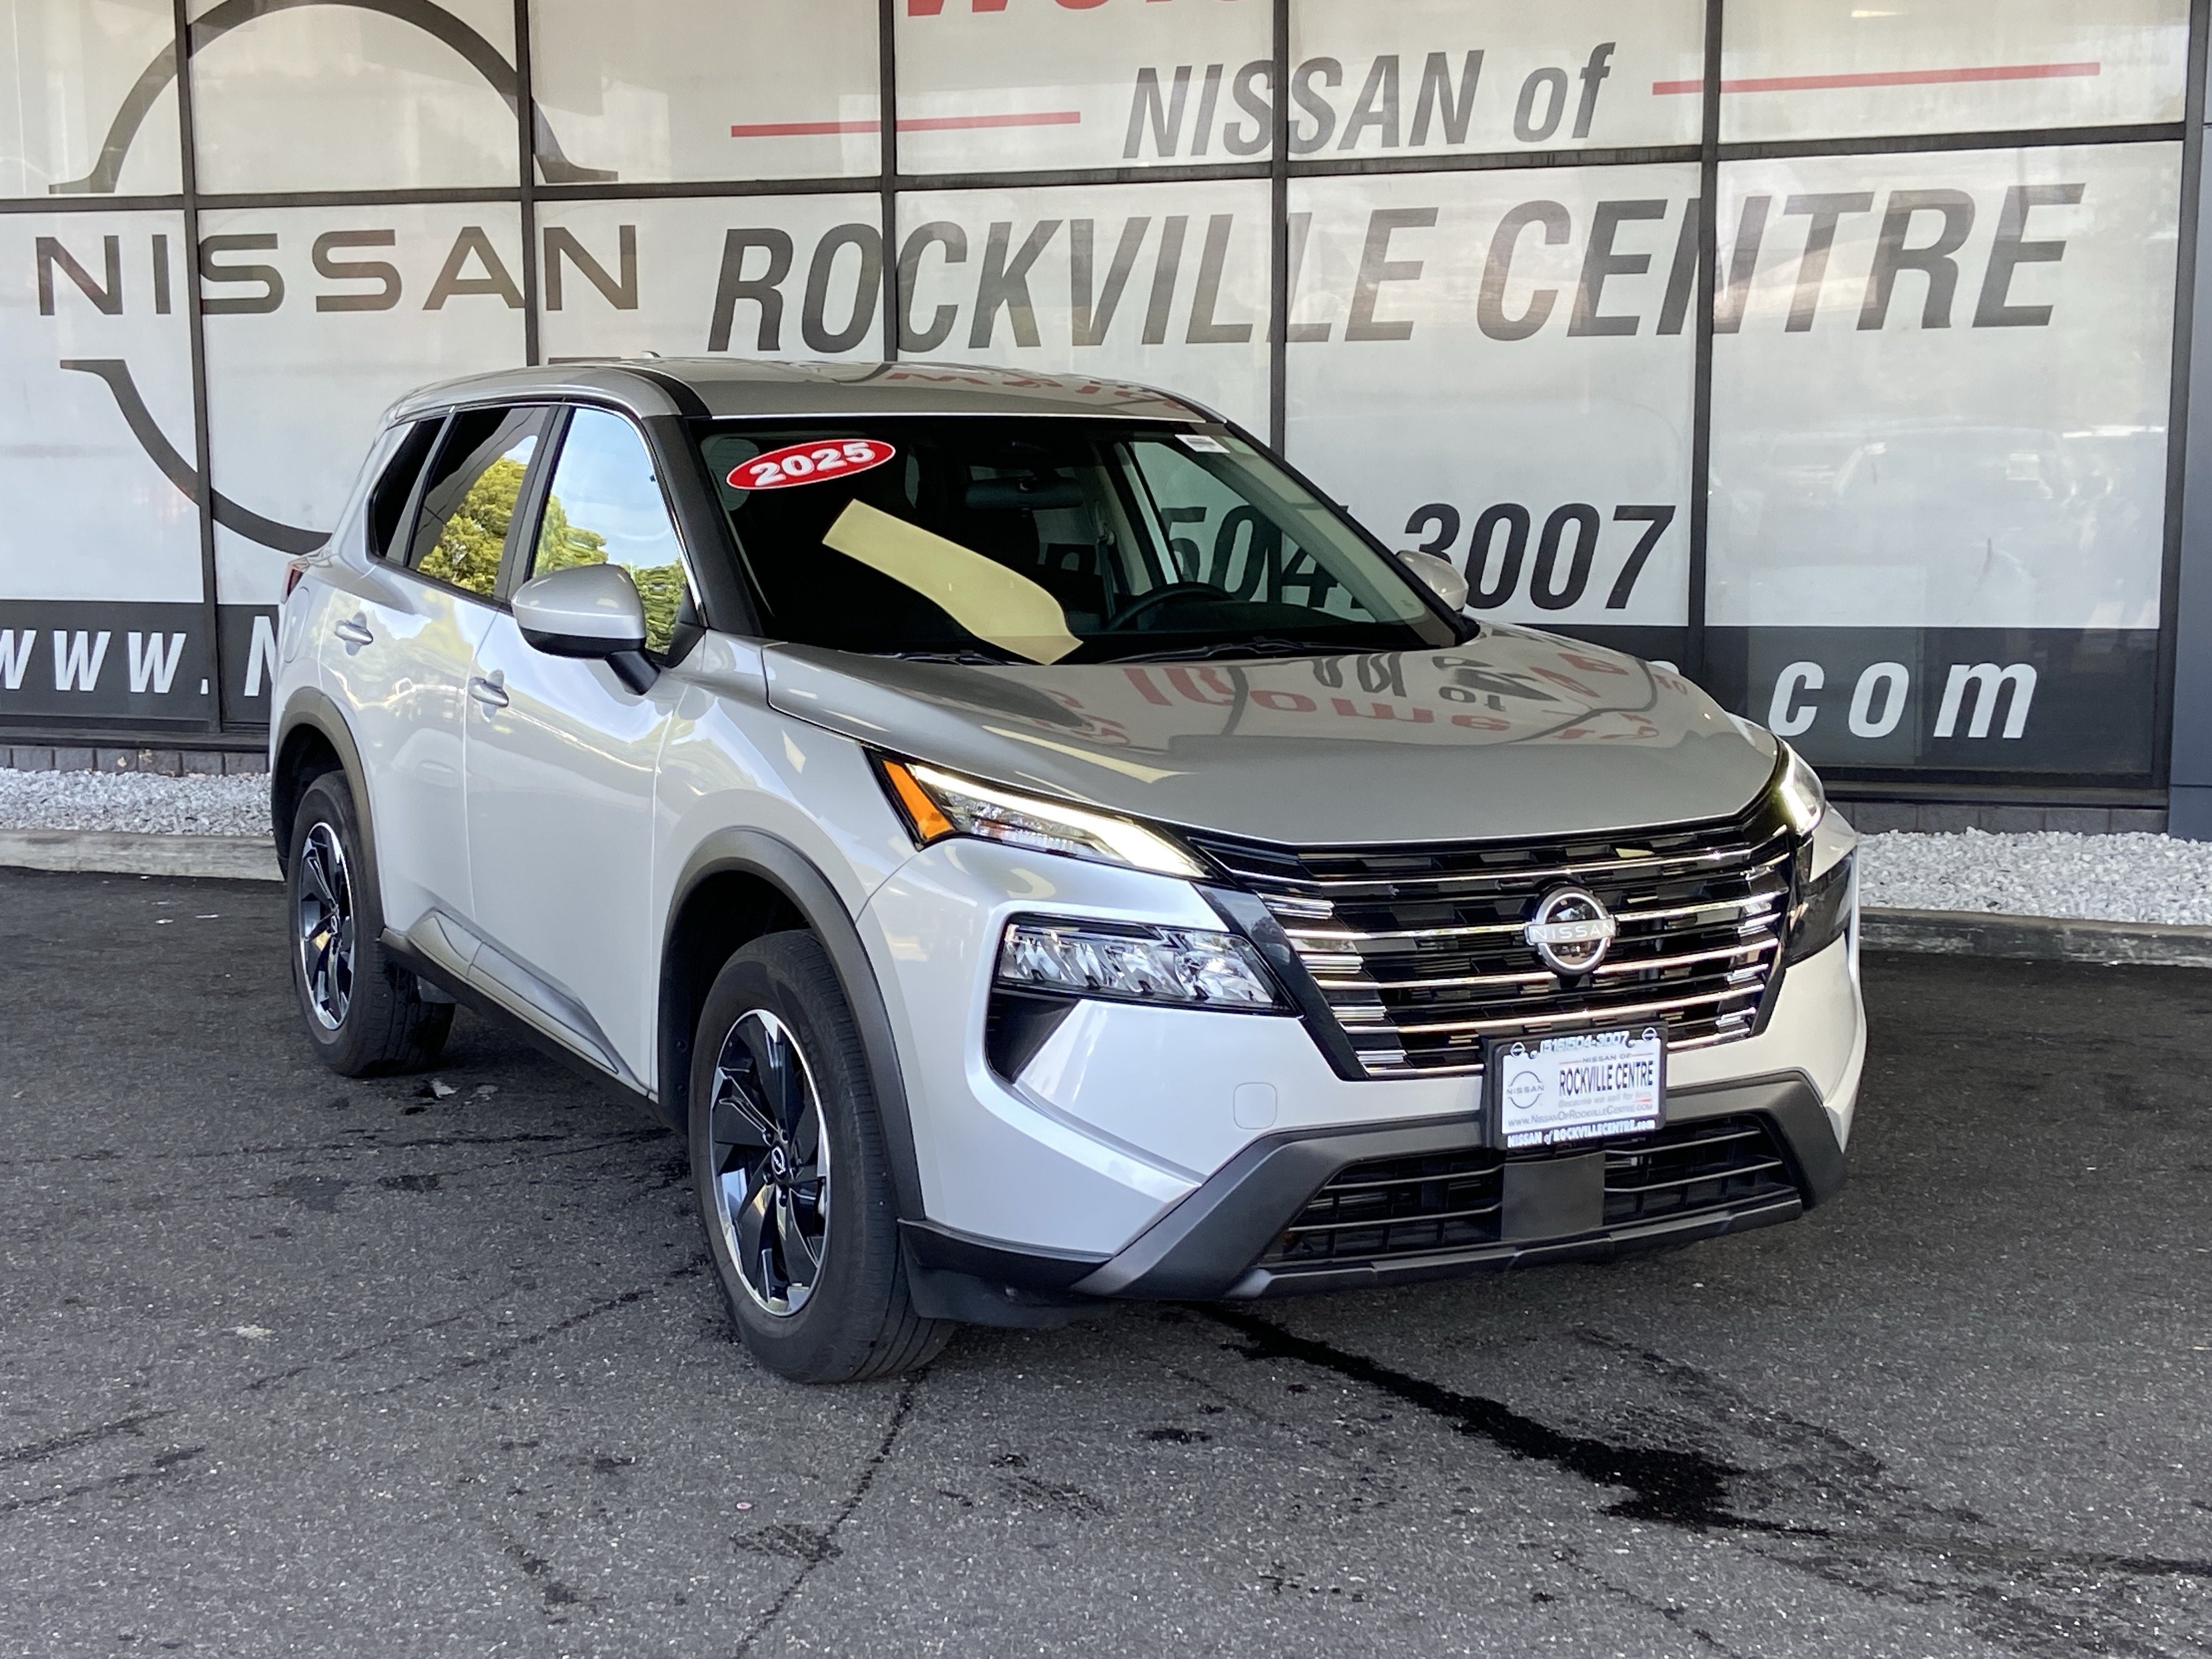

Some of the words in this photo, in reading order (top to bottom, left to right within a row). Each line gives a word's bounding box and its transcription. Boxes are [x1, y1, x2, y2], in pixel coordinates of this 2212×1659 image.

[1122, 49, 1485, 159] NISSAN
[1513, 42, 1616, 143] of
[36, 224, 639, 315] NISSAN
[707, 207, 1438, 354] ROCKVILLE
[1476, 182, 2086, 341] CENTRE
[749, 442, 876, 487] 2025
[1532, 922, 1613, 940] NISSAN
[1582, 1054, 1617, 1063] NISSAN
[1506, 1084, 1544, 1096] NISSAN
[1559, 1064, 1613, 1096] ROCKVILLE
[1616, 1060, 1654, 1090] CENTRE
[1507, 1131, 1543, 1148] NISSAN
